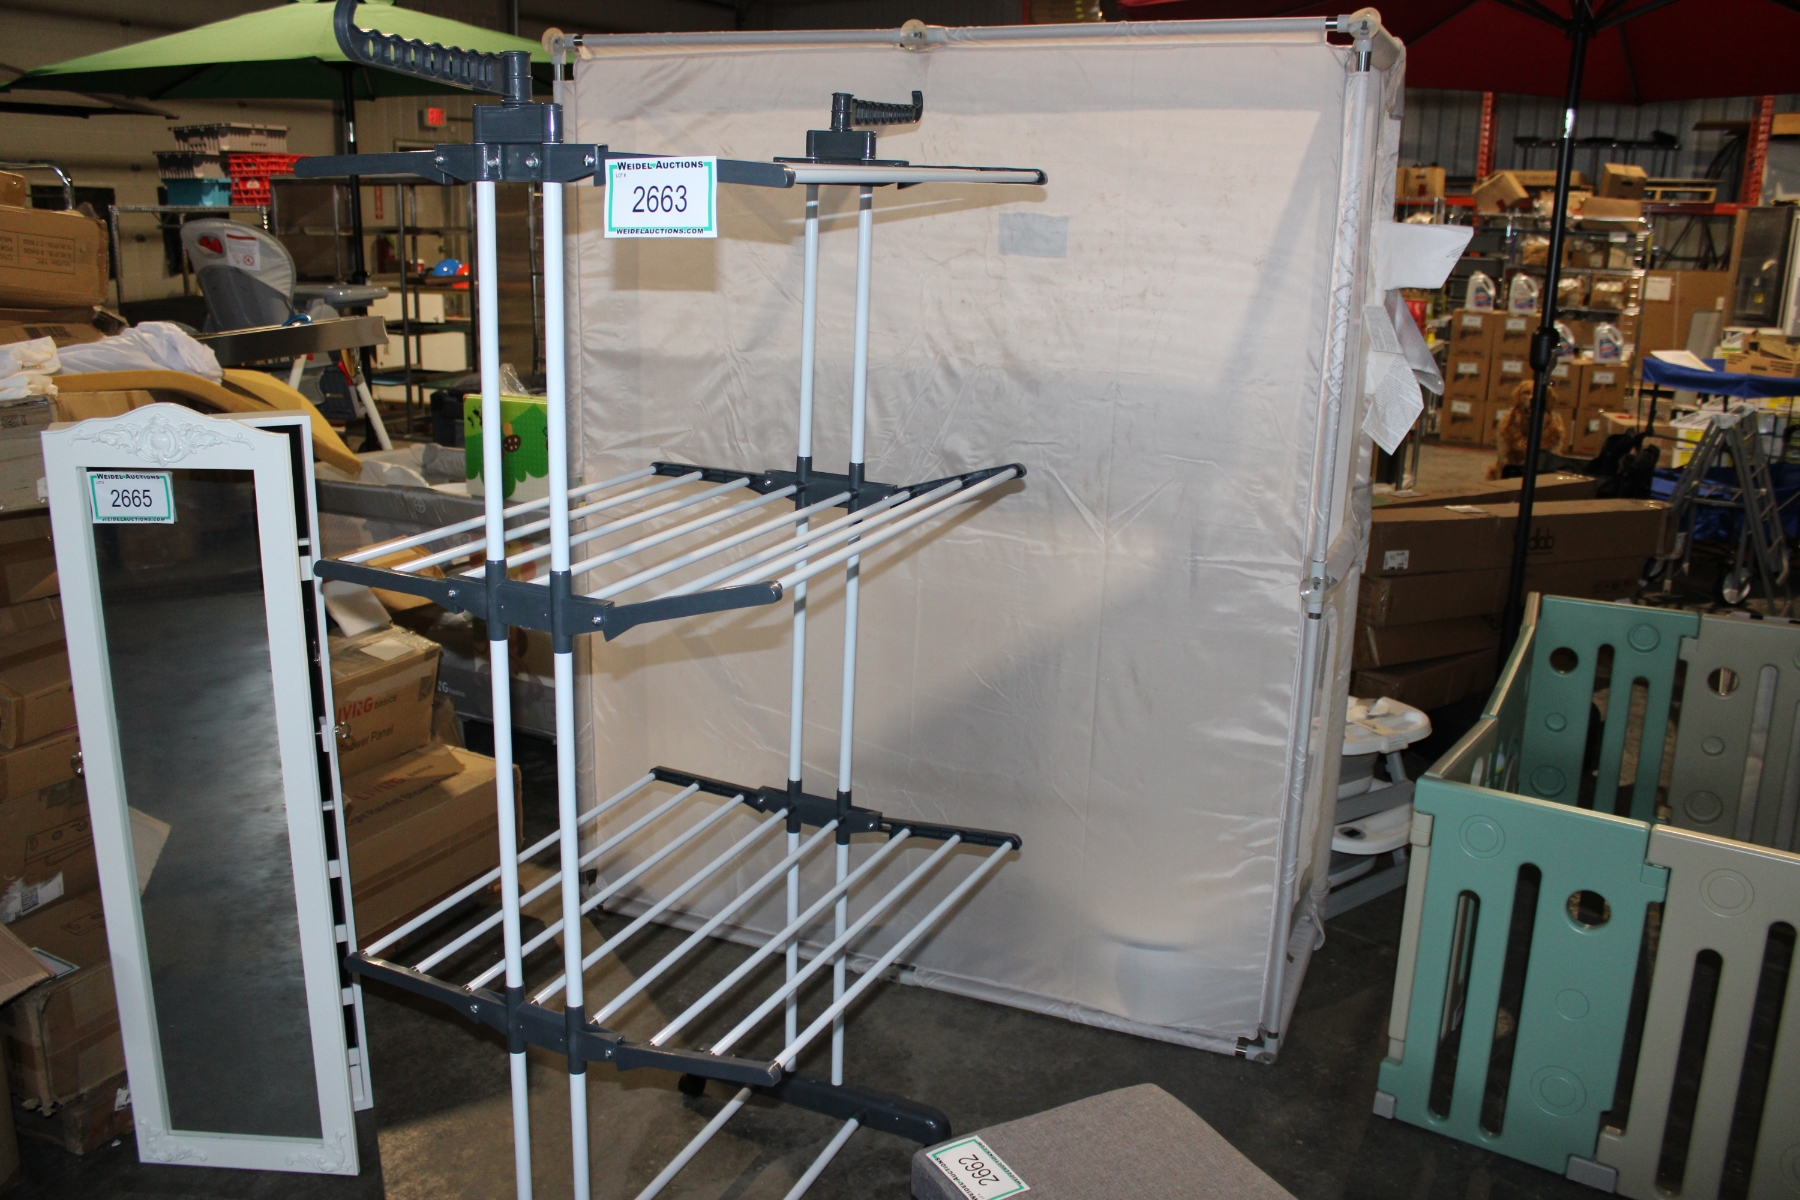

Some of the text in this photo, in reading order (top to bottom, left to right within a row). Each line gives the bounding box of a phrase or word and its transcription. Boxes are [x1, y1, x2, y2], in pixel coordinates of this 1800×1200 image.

[617, 160, 704, 170] WEIDEL AUCTIONS
[632, 185, 687, 213] 2663
[110, 489, 153, 508] 2665
[337, 697, 373, 724] IVING
[370, 725, 394, 743] Panel
[958, 1153, 1000, 1186] 2662
